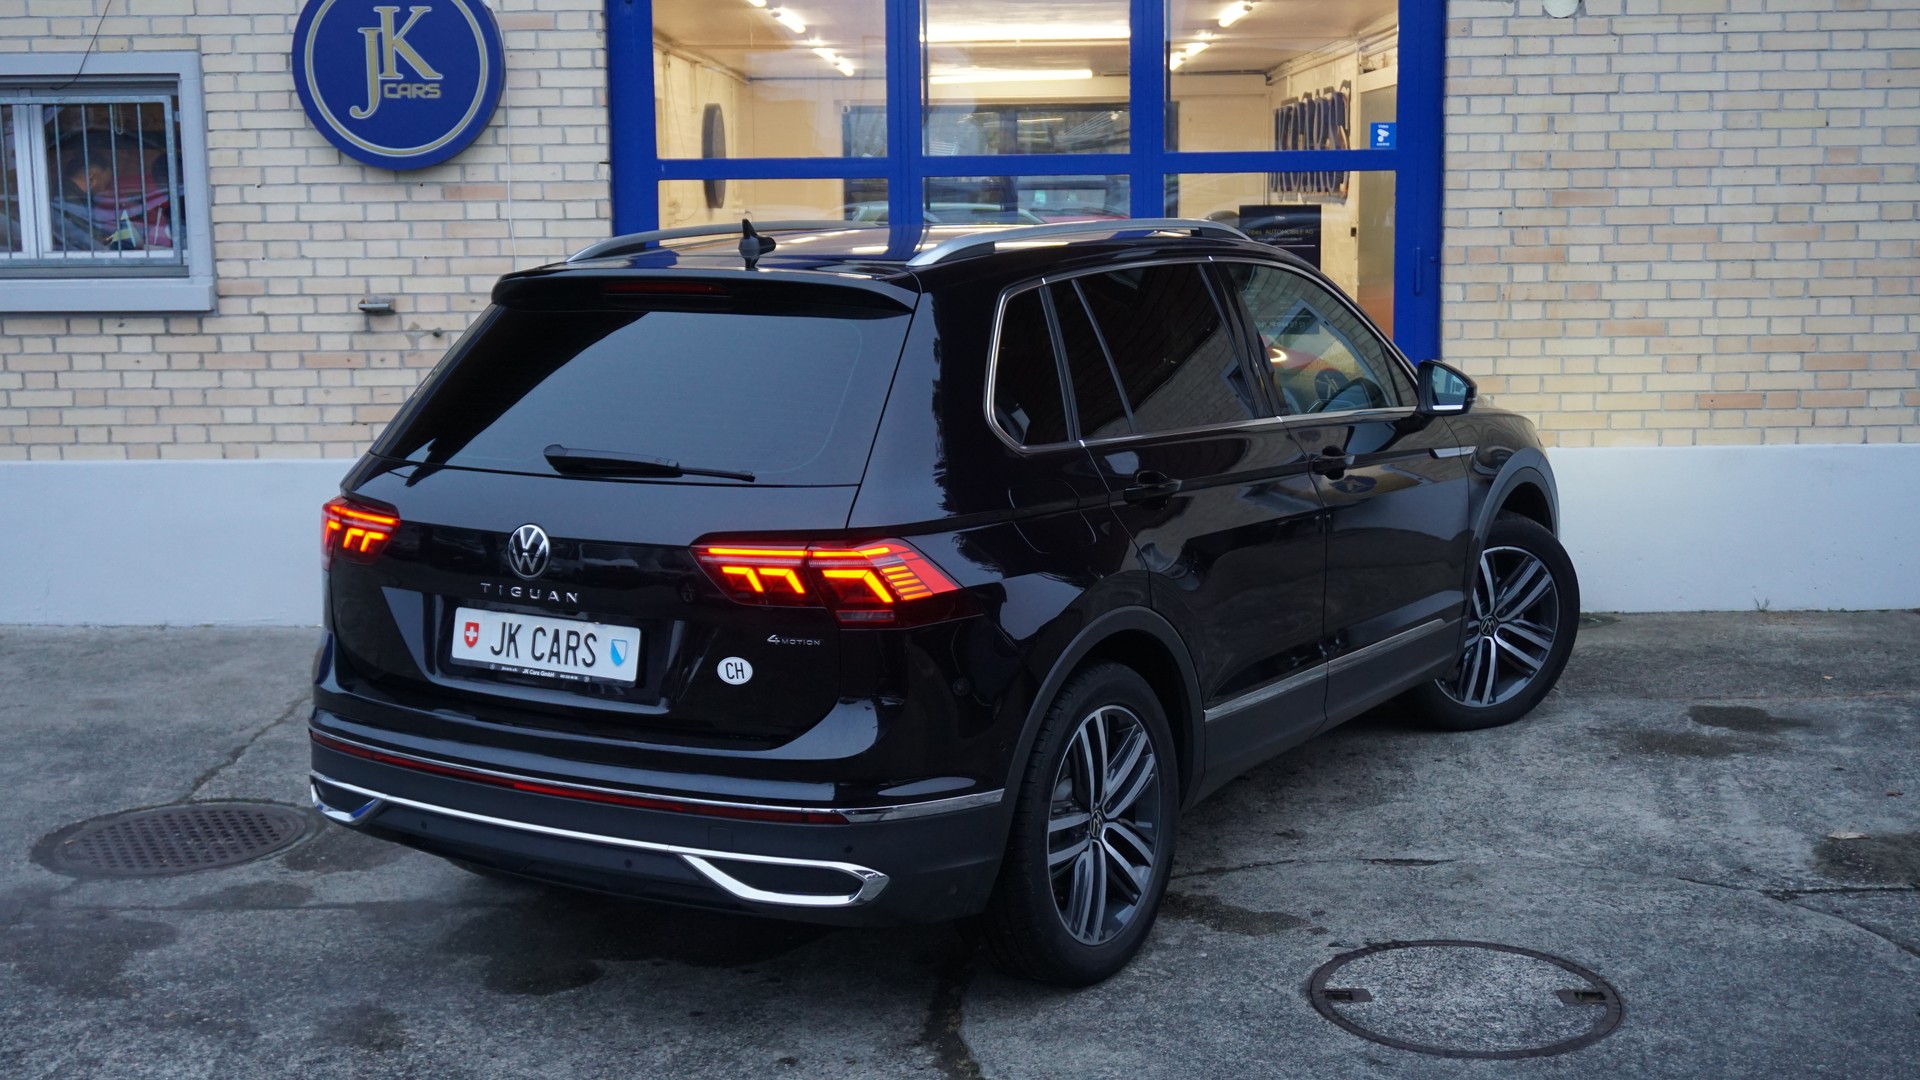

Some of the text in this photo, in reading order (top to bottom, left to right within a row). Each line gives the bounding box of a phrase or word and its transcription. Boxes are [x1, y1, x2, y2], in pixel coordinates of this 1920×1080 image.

[349, 6, 444, 119] JK
[383, 83, 442, 98] CARS
[489, 621, 597, 667] JK CARS
[767, 634, 821, 645] 4MOTION
[725, 662, 745, 680] CH
